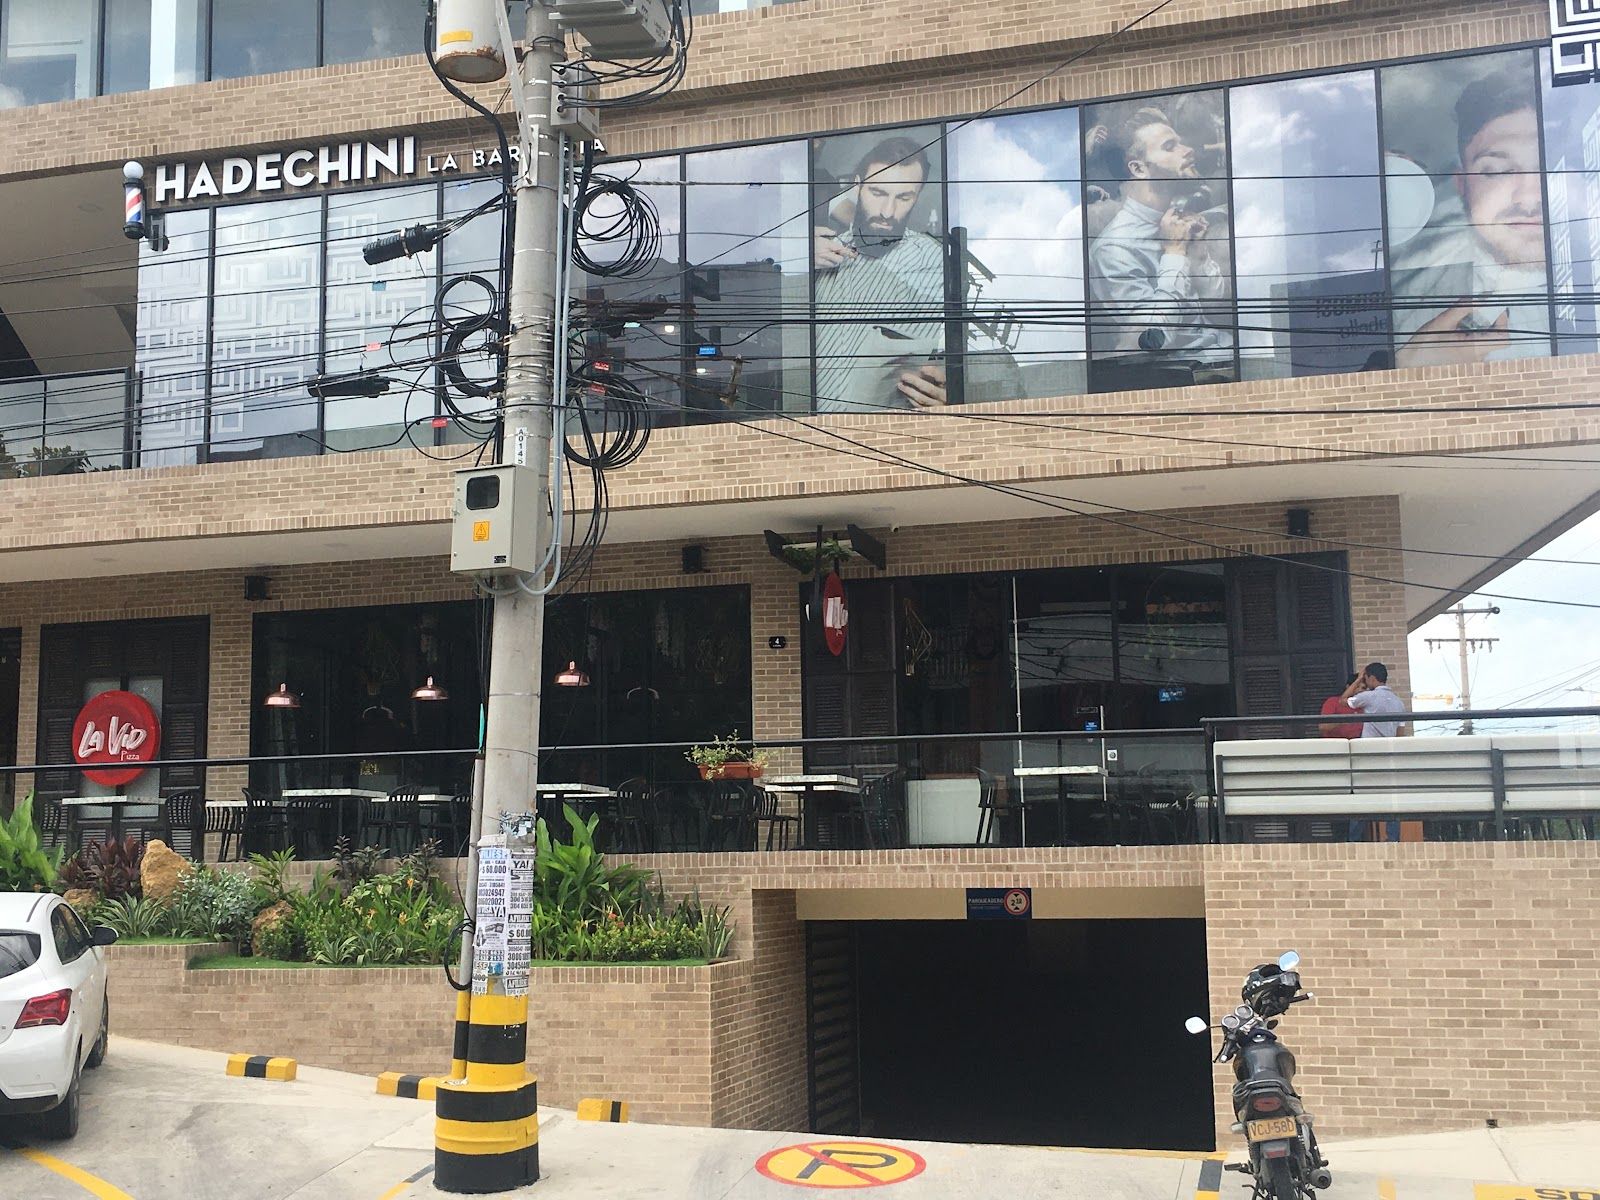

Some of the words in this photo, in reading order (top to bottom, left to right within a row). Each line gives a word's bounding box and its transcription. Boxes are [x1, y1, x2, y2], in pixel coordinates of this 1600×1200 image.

[156, 136, 414, 202] HADECHINI
[427, 154, 458, 172] LA
[473, 138, 605, 167] BARIA
